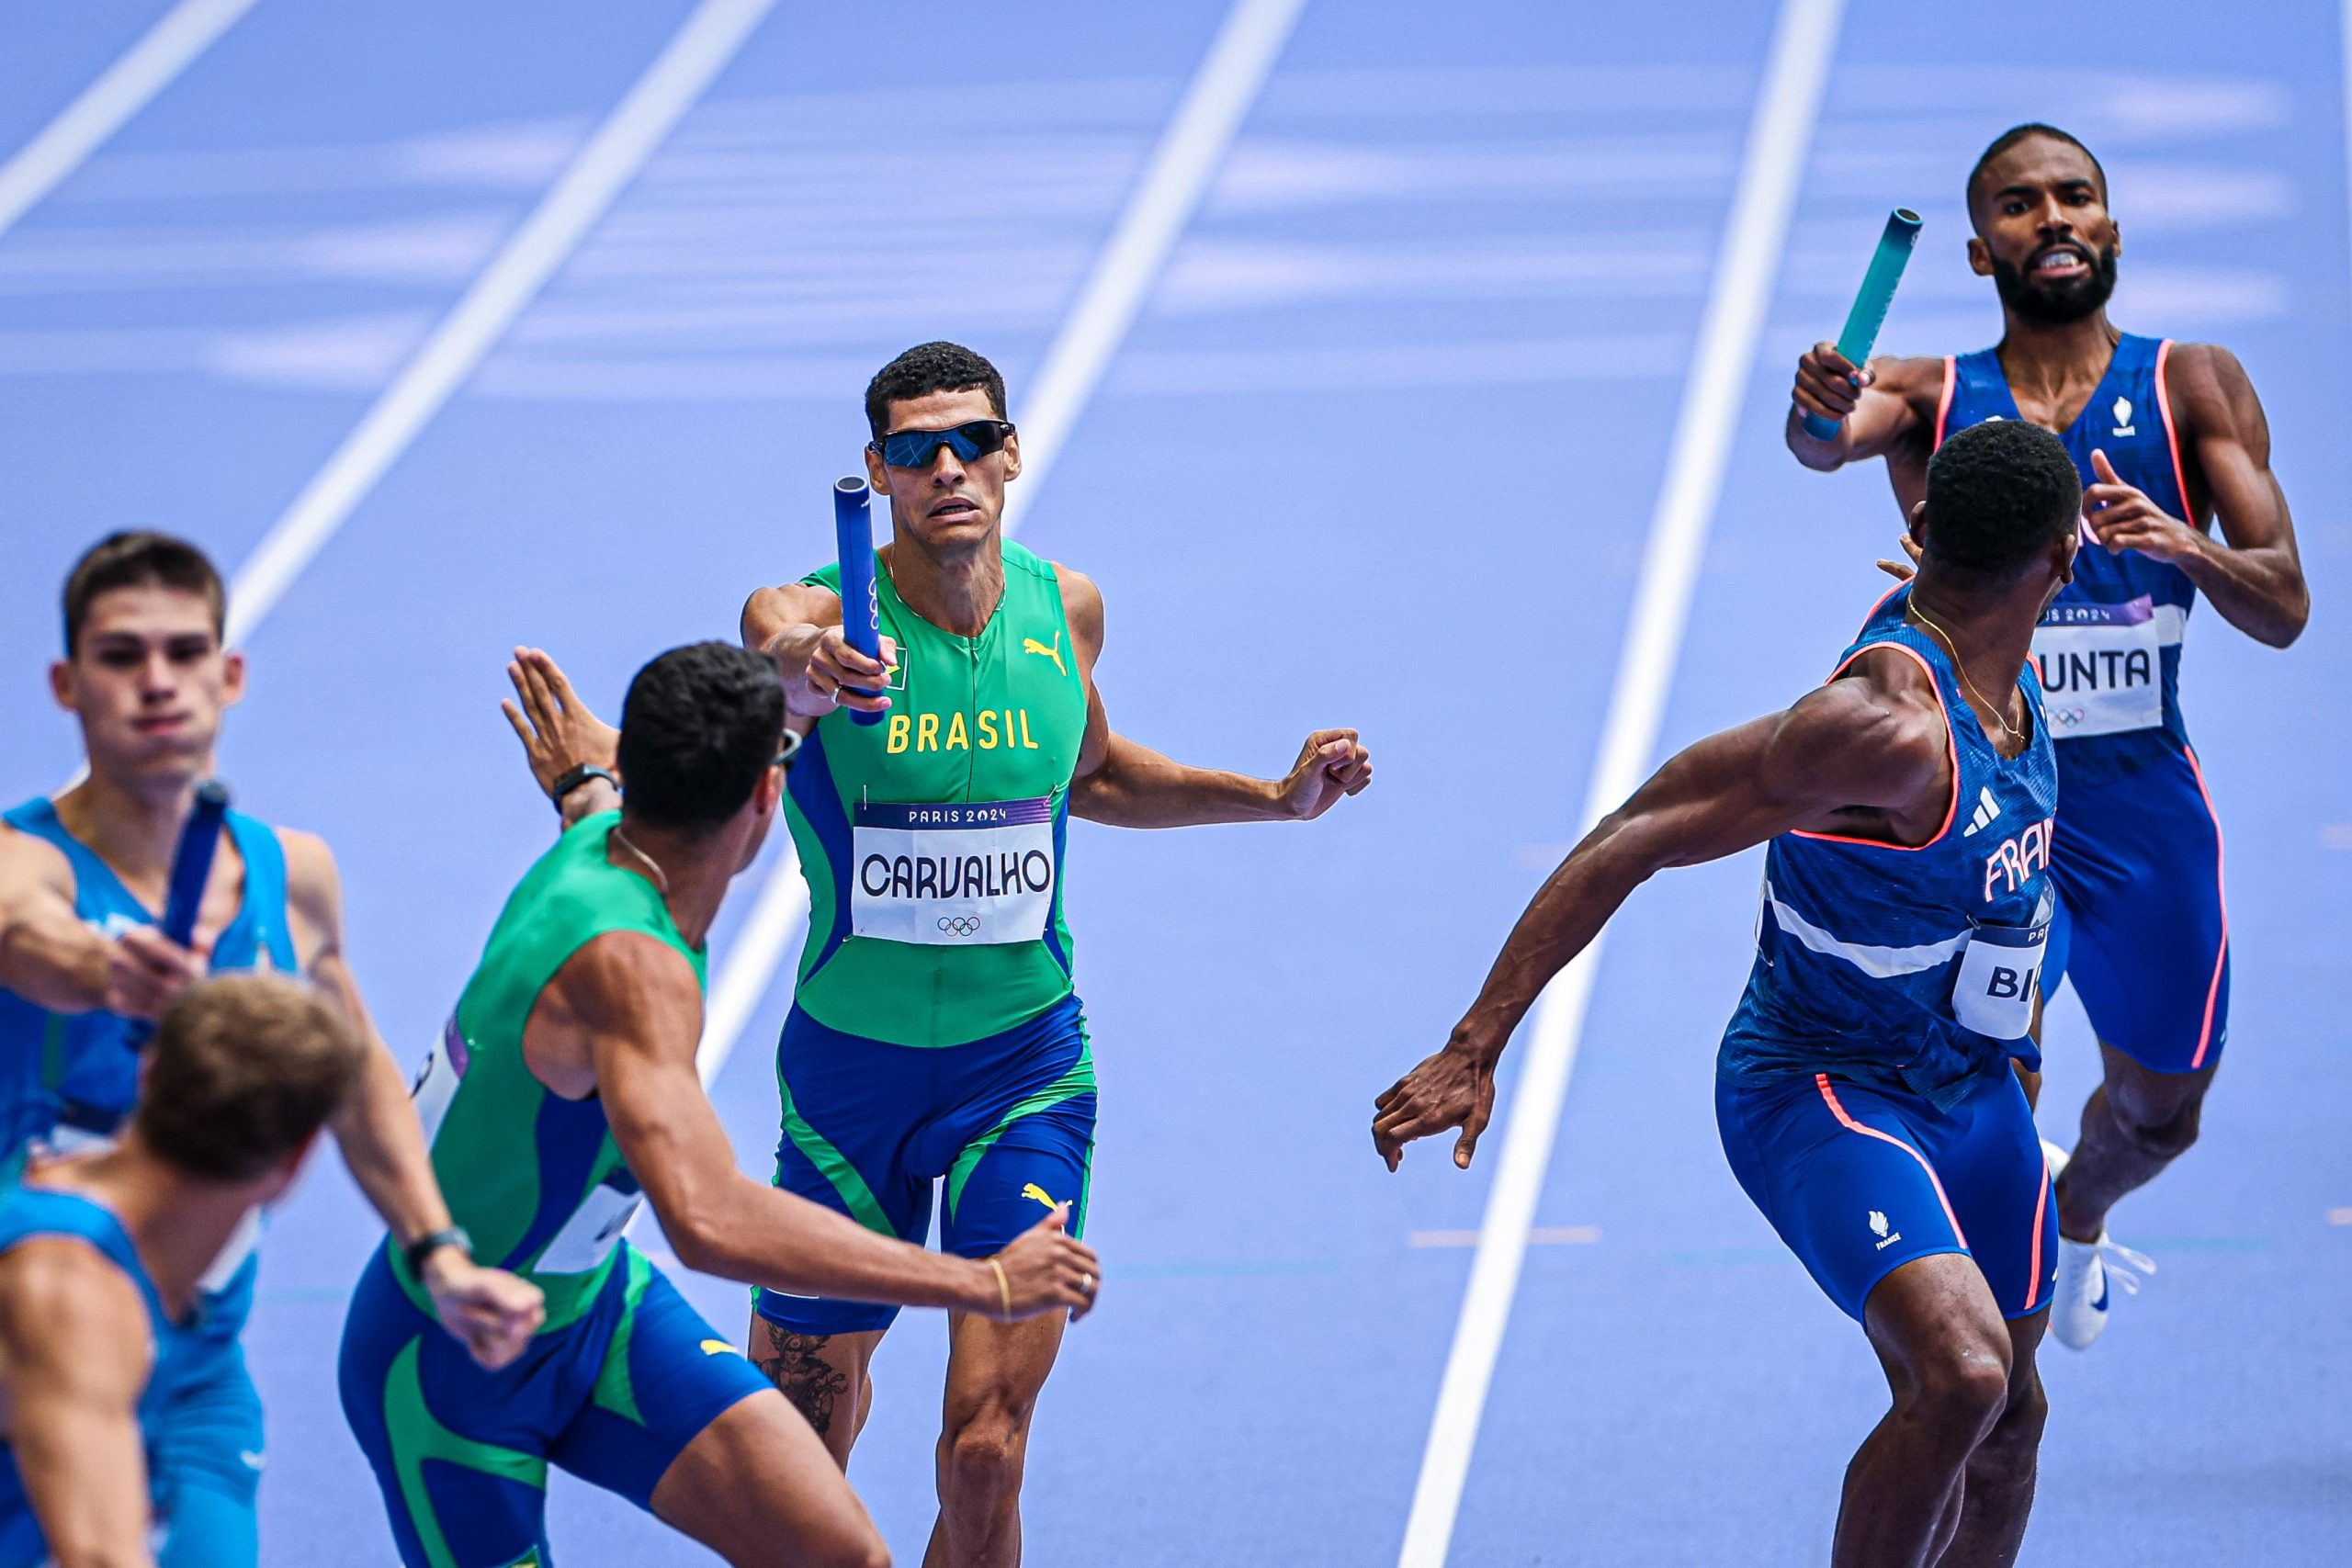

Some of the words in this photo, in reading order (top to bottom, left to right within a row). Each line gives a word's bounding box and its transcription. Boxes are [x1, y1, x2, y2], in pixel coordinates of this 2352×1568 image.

[2065, 608, 2110, 622] 2024
[2040, 649, 2151, 693] UNTA
[887, 708, 1039, 754] BRASIL
[909, 810, 959, 823] PARIS
[966, 808, 1006, 822] 2024
[860, 850, 1051, 899] CARVALHO
[2028, 924, 2048, 942] PA
[1986, 965, 2038, 1002] BI
